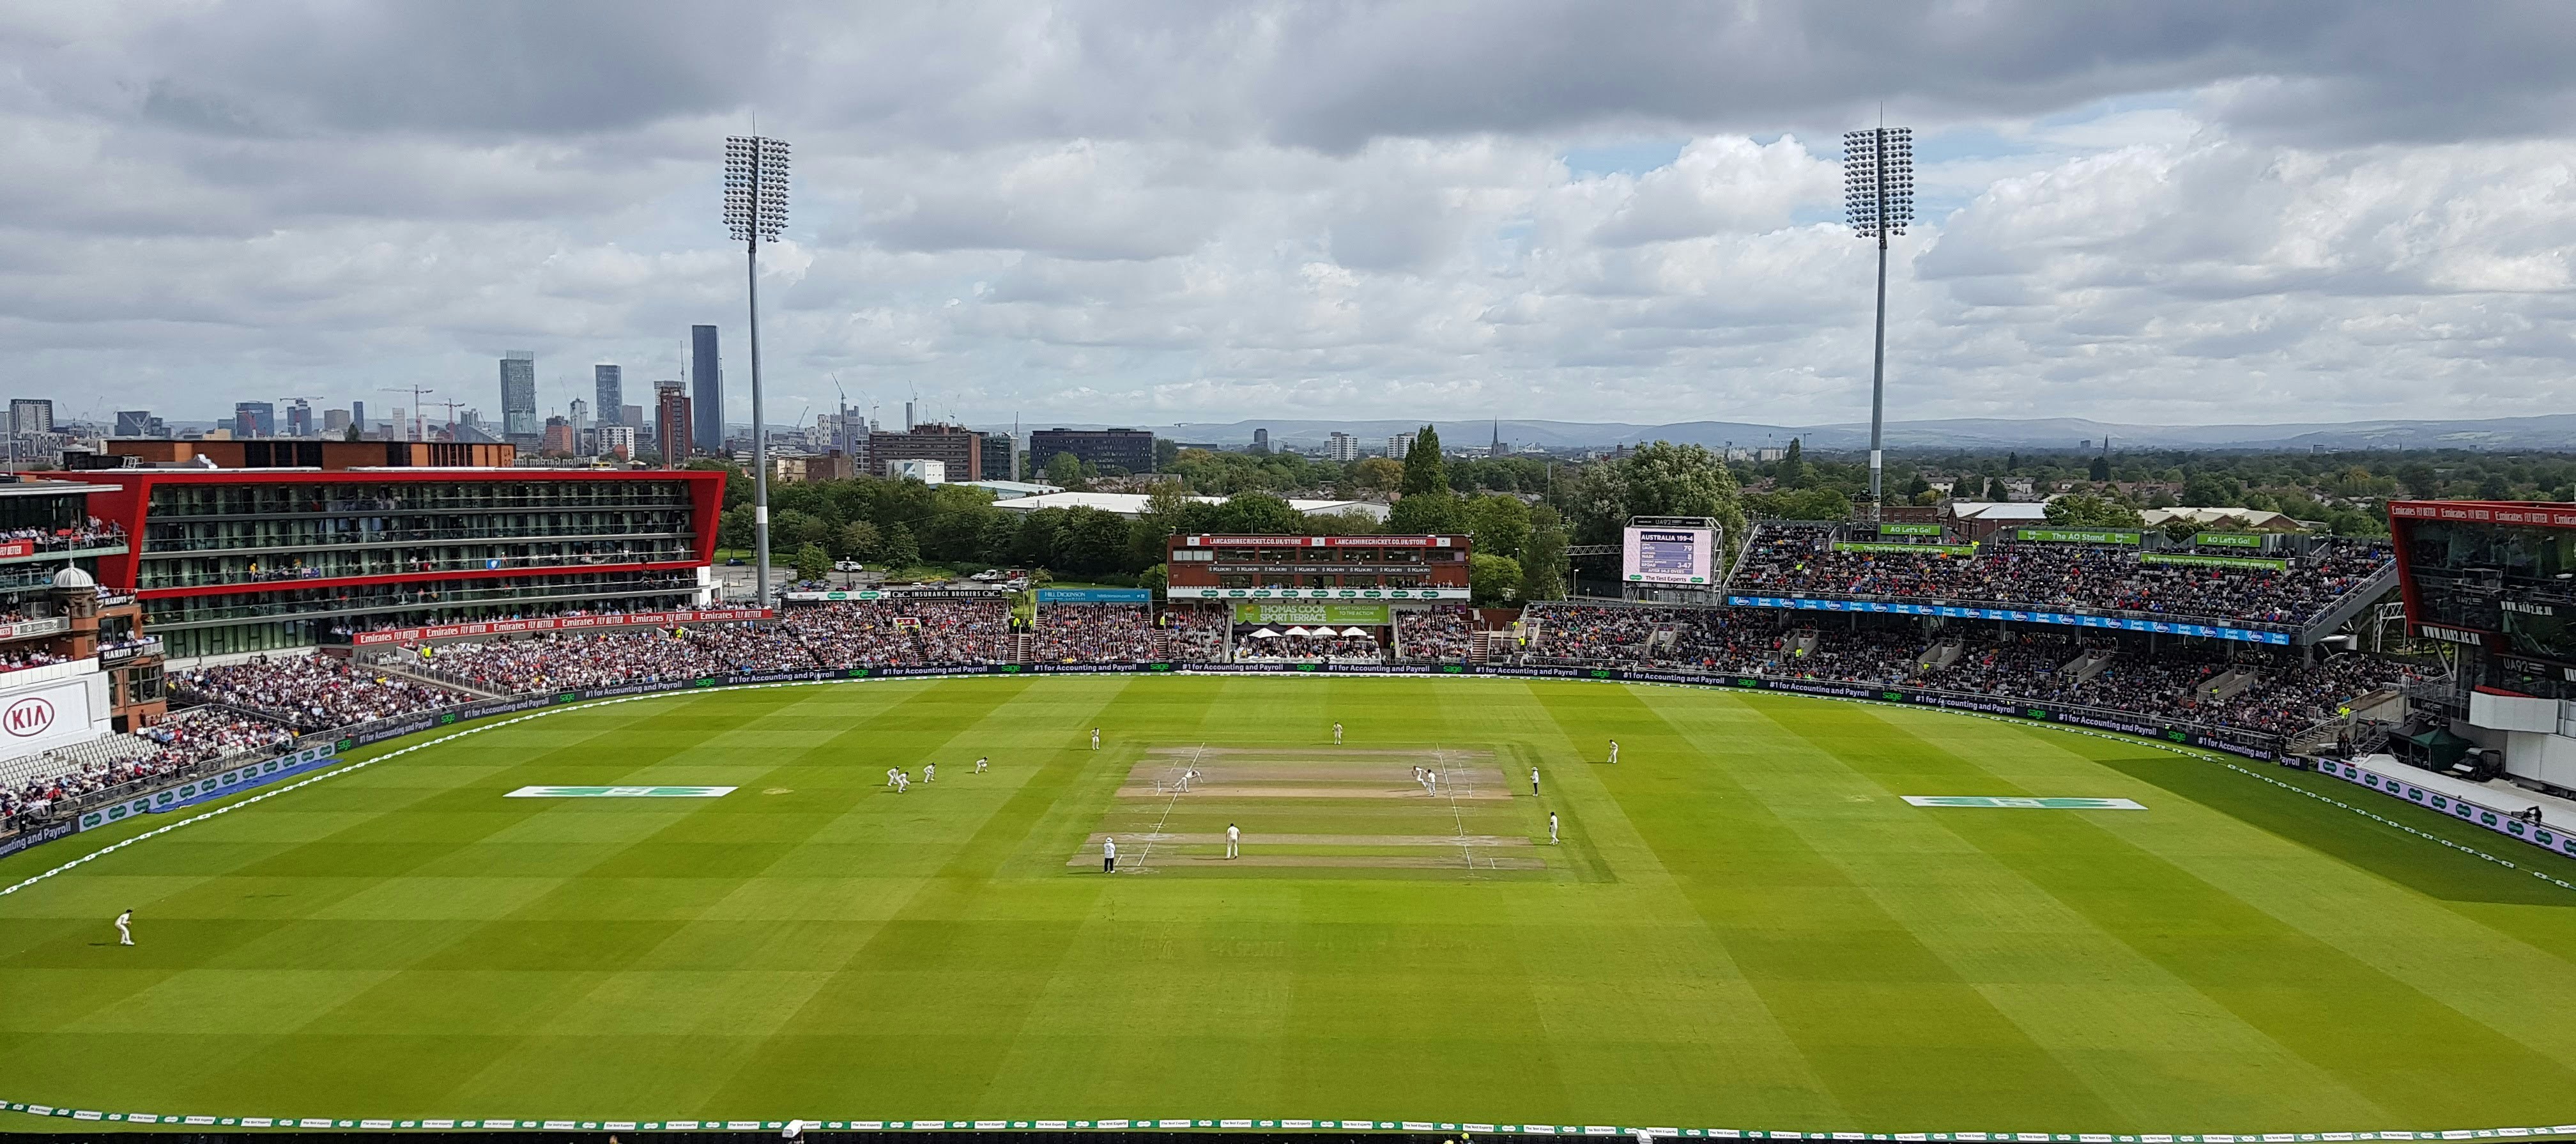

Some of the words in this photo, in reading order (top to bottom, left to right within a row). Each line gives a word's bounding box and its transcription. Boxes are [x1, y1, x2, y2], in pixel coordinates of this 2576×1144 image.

[1260, 605, 1296, 614] THOMAS
[562, 618, 594, 627] Emirates
[597, 617, 606, 625] FLY
[606, 615, 624, 624] BETTER
[631, 615, 663, 623] Emirates
[675, 613, 692, 621] BETTER
[700, 612, 733, 620] Emirates
[1260, 614, 1289, 622] SPORT
[1290, 614, 1326, 622] TERRACE
[494, 622, 525, 631] Emirates
[528, 621, 536, 629] FLY
[537, 620, 554, 628] BETTER
[361, 633, 392, 644] Emirates
[394, 631, 402, 640] FLY
[402, 630, 419, 639] BETTER
[427, 628, 458, 637] Emirates
[905, 667, 947, 675] Accounting
[963, 665, 987, 674] Payroll
[1001, 665, 1020, 673] sage
[1204, 663, 1244, 672] Accounting
[2503, 658, 2529, 672] UA92
[751, 672, 792, 682] Accounting
[849, 669, 869, 677] sage
[1498, 667, 1538, 675] Accounting
[1554, 669, 1577, 677] Payroll
[696, 678, 715, 687] sage
[1644, 674, 1685, 683] Accounting
[1701, 677, 1724, 685] Payroll
[1738, 679, 1756, 687] sage
[594, 688, 603, 697] for
[604, 683, 642, 695] Accounting
[644, 682, 656, 690] and
[658, 681, 682, 691] Payroll
[1846, 688, 1869, 697] Payroll
[560, 692, 575, 702] sage
[1882, 692, 1902, 701] sage
[464, 710, 471, 718] #1
[481, 702, 516, 716] Accounting
[517, 700, 528, 709] and
[529, 697, 549, 707] Payroll
[1993, 704, 2014, 714] Payroll
[441, 713, 456, 724] sage
[2028, 708, 2046, 719] sage
[2069, 715, 2080, 723] for
[2081, 716, 2120, 730] Accounting
[2122, 723, 2133, 731] and
[2135, 723, 2157, 735] Payroll
[360, 735, 365, 743] #1
[366, 733, 374, 741] for
[375, 726, 404, 741] Accounting
[405, 723, 414, 733] and
[415, 719, 433, 733] Payroll
[2168, 730, 2186, 742] sage
[338, 739, 351, 751] sage
[2198, 737, 2207, 745] #1
[2207, 739, 2218, 748] for
[2219, 741, 2255, 759] Accounting
[2256, 750, 2267, 759] and
[27, 833, 42, 844] and
[43, 821, 71, 840] Payroll
